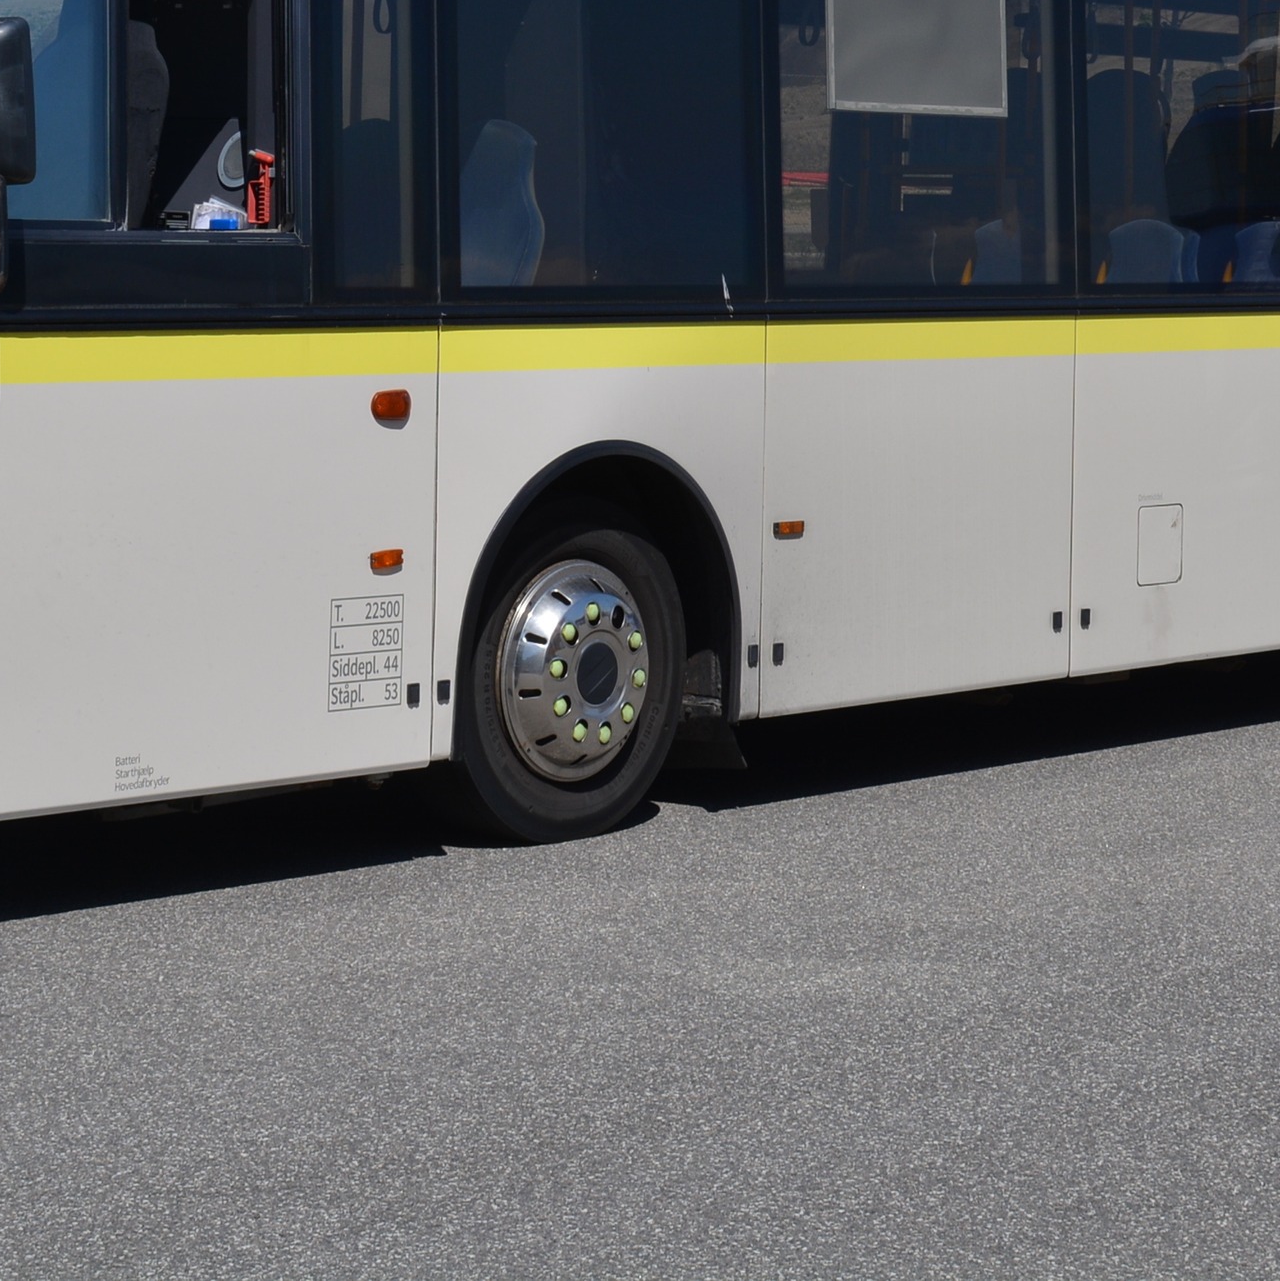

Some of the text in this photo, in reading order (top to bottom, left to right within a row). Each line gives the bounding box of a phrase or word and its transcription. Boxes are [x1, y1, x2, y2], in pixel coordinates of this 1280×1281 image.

[335, 601, 400, 622] T. 22500
[334, 628, 399, 649] L. 8250
[332, 655, 398, 680] Siddepl. 44
[331, 682, 398, 708] Ståpl. 53
[115, 754, 140, 766] Batteri
[115, 776, 169, 791] Hovedafbryder
